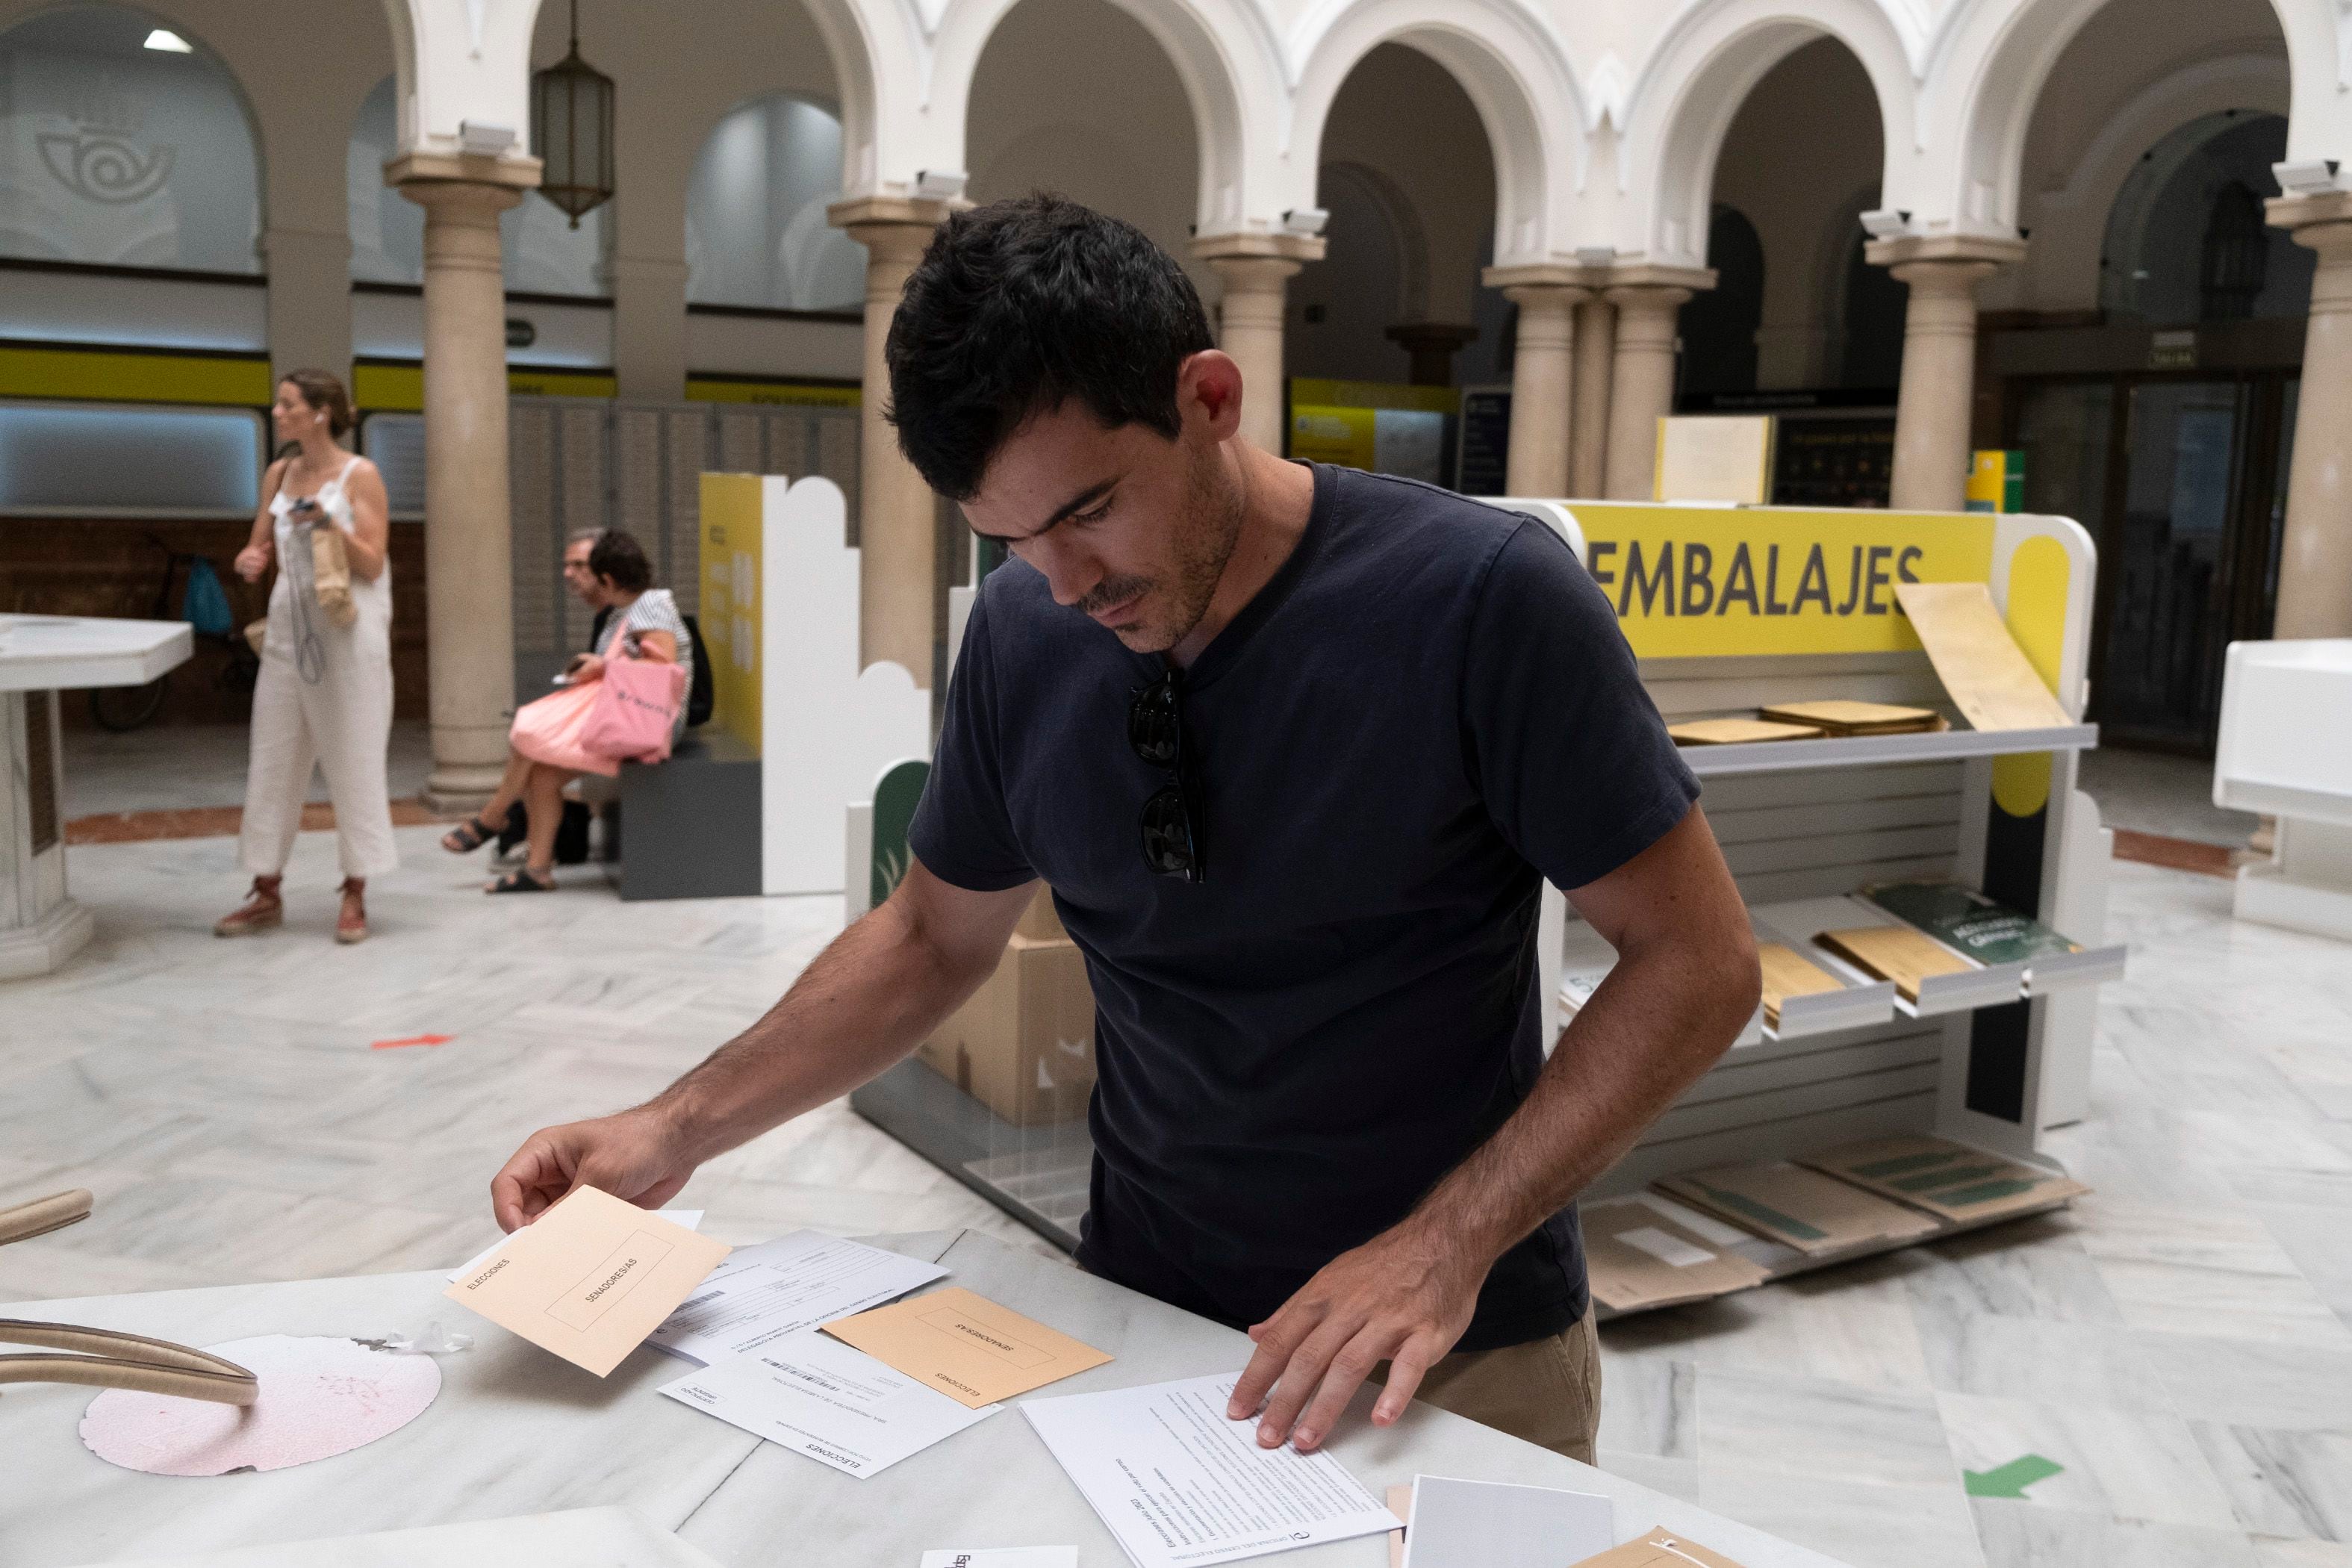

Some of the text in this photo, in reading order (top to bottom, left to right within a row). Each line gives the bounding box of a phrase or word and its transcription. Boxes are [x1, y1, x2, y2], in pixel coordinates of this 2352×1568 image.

[1587, 540, 1924, 617] EMBALAJES
[466, 1258, 510, 1290] ELECCIONES
[584, 1257, 638, 1303] SENADORES/AS
[933, 1372, 981, 1396] ELECCIONES
[804, 1443, 862, 1468] ELECCIONES
[1130, 1499, 1145, 1510] 2023
[1148, 1521, 1177, 1547] Elecciones
[1213, 1545, 1240, 1553] CENSO
